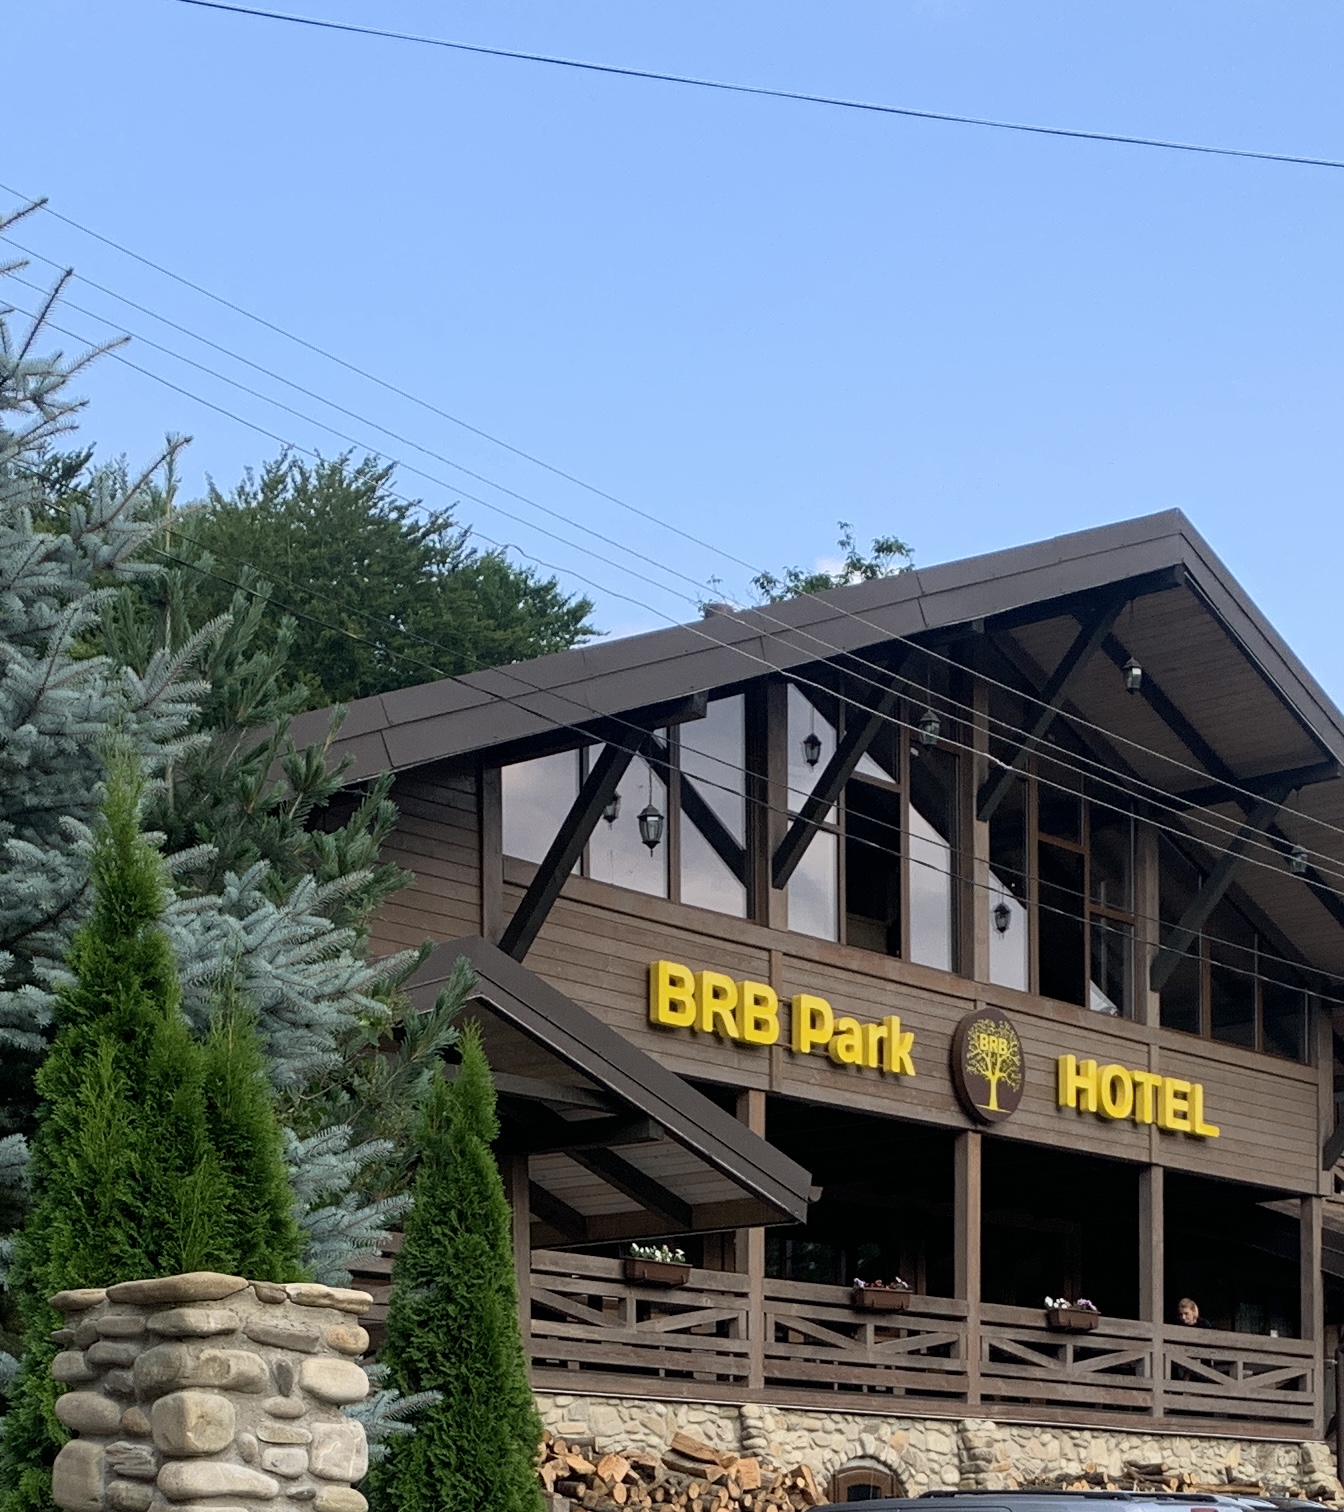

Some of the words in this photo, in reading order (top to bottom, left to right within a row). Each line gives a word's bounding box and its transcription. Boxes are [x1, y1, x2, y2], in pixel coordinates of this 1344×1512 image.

[650, 960, 780, 1045] BRB
[792, 993, 915, 1077] Park
[979, 1034, 1008, 1055] BRB
[1058, 1054, 1221, 1138] HOTEL
